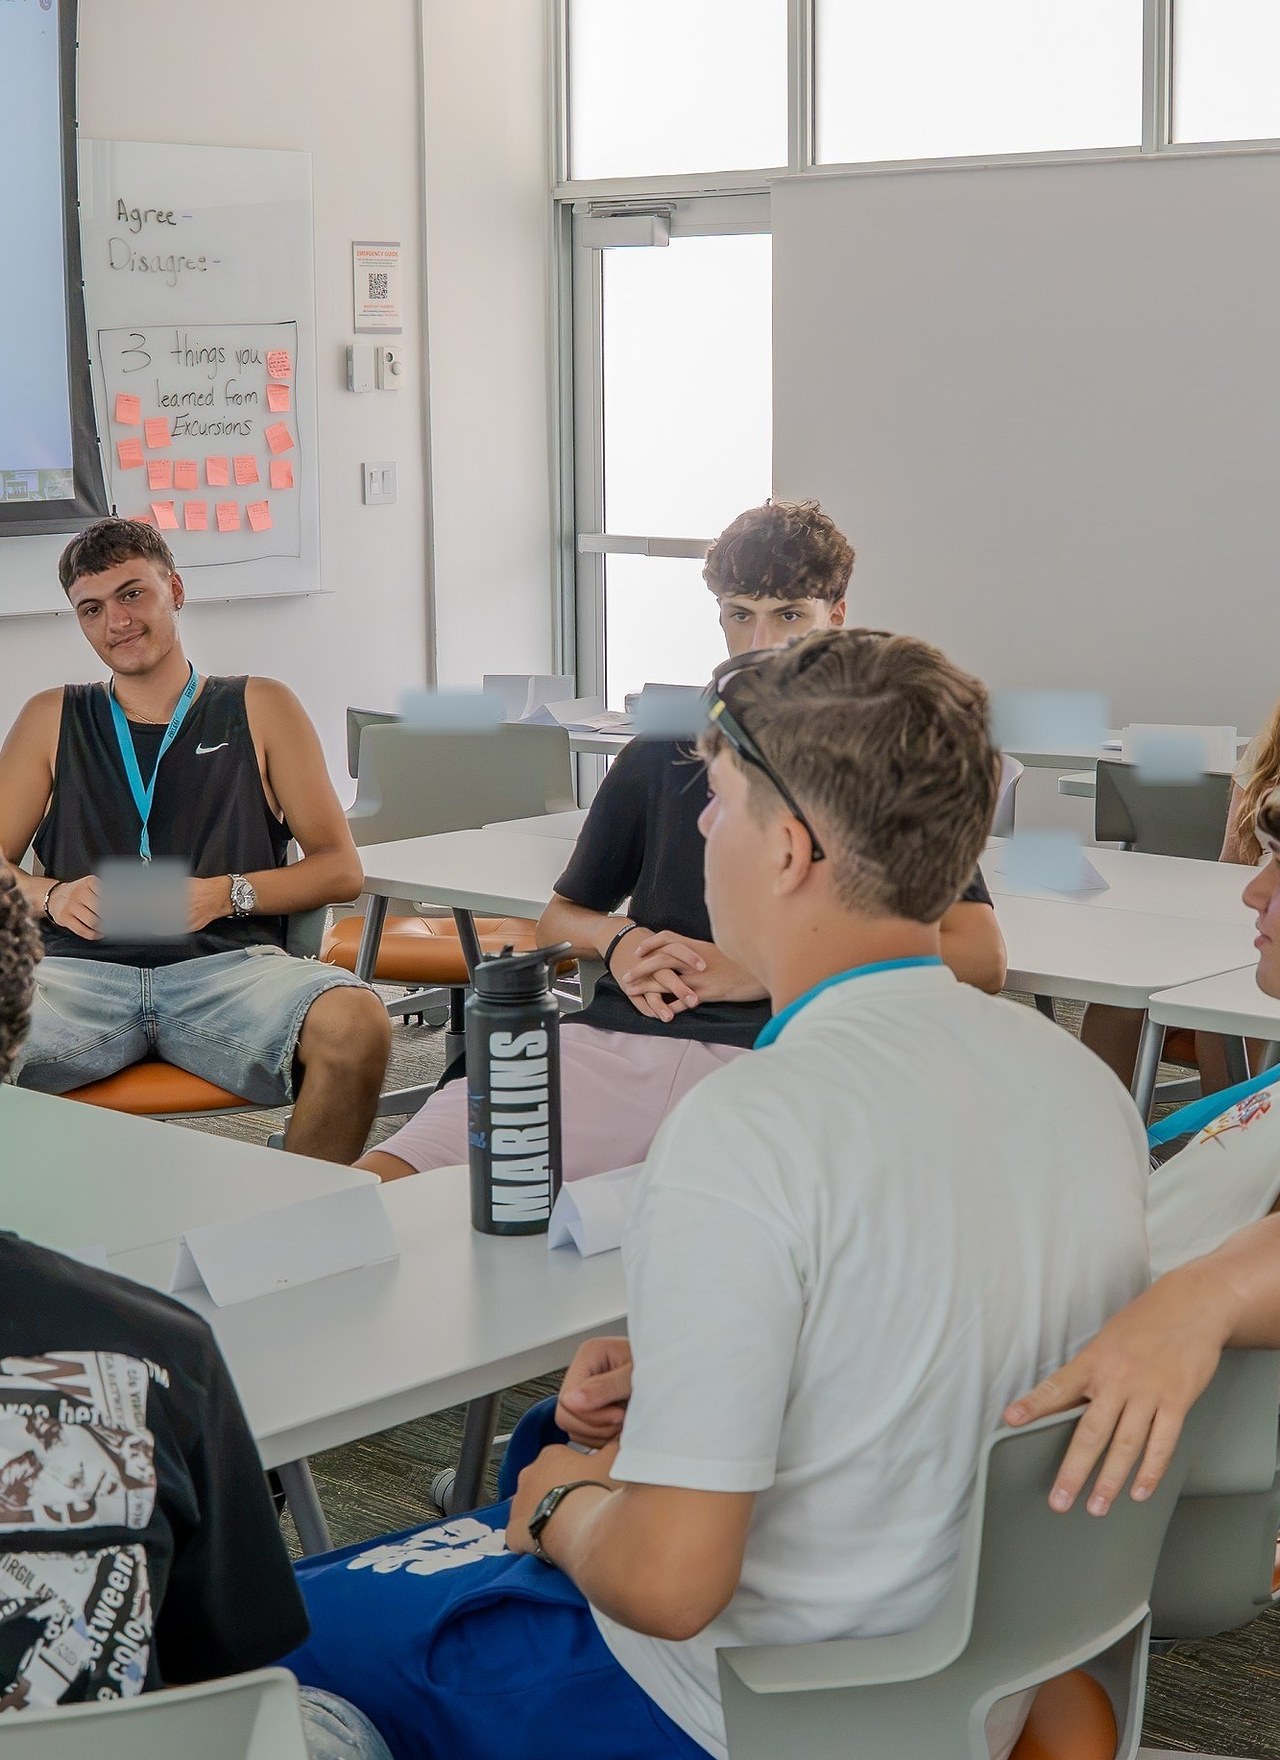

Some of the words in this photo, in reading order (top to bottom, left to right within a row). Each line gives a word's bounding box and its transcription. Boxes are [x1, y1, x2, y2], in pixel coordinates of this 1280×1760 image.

[121, 332, 152, 373] 3
[170, 330, 226, 379] things
[233, 346, 263, 372] you
[156, 379, 215, 409] learned
[225, 378, 259, 406] from
[171, 413, 252, 438] Excursions
[489, 1030, 549, 1222] MARLINS
